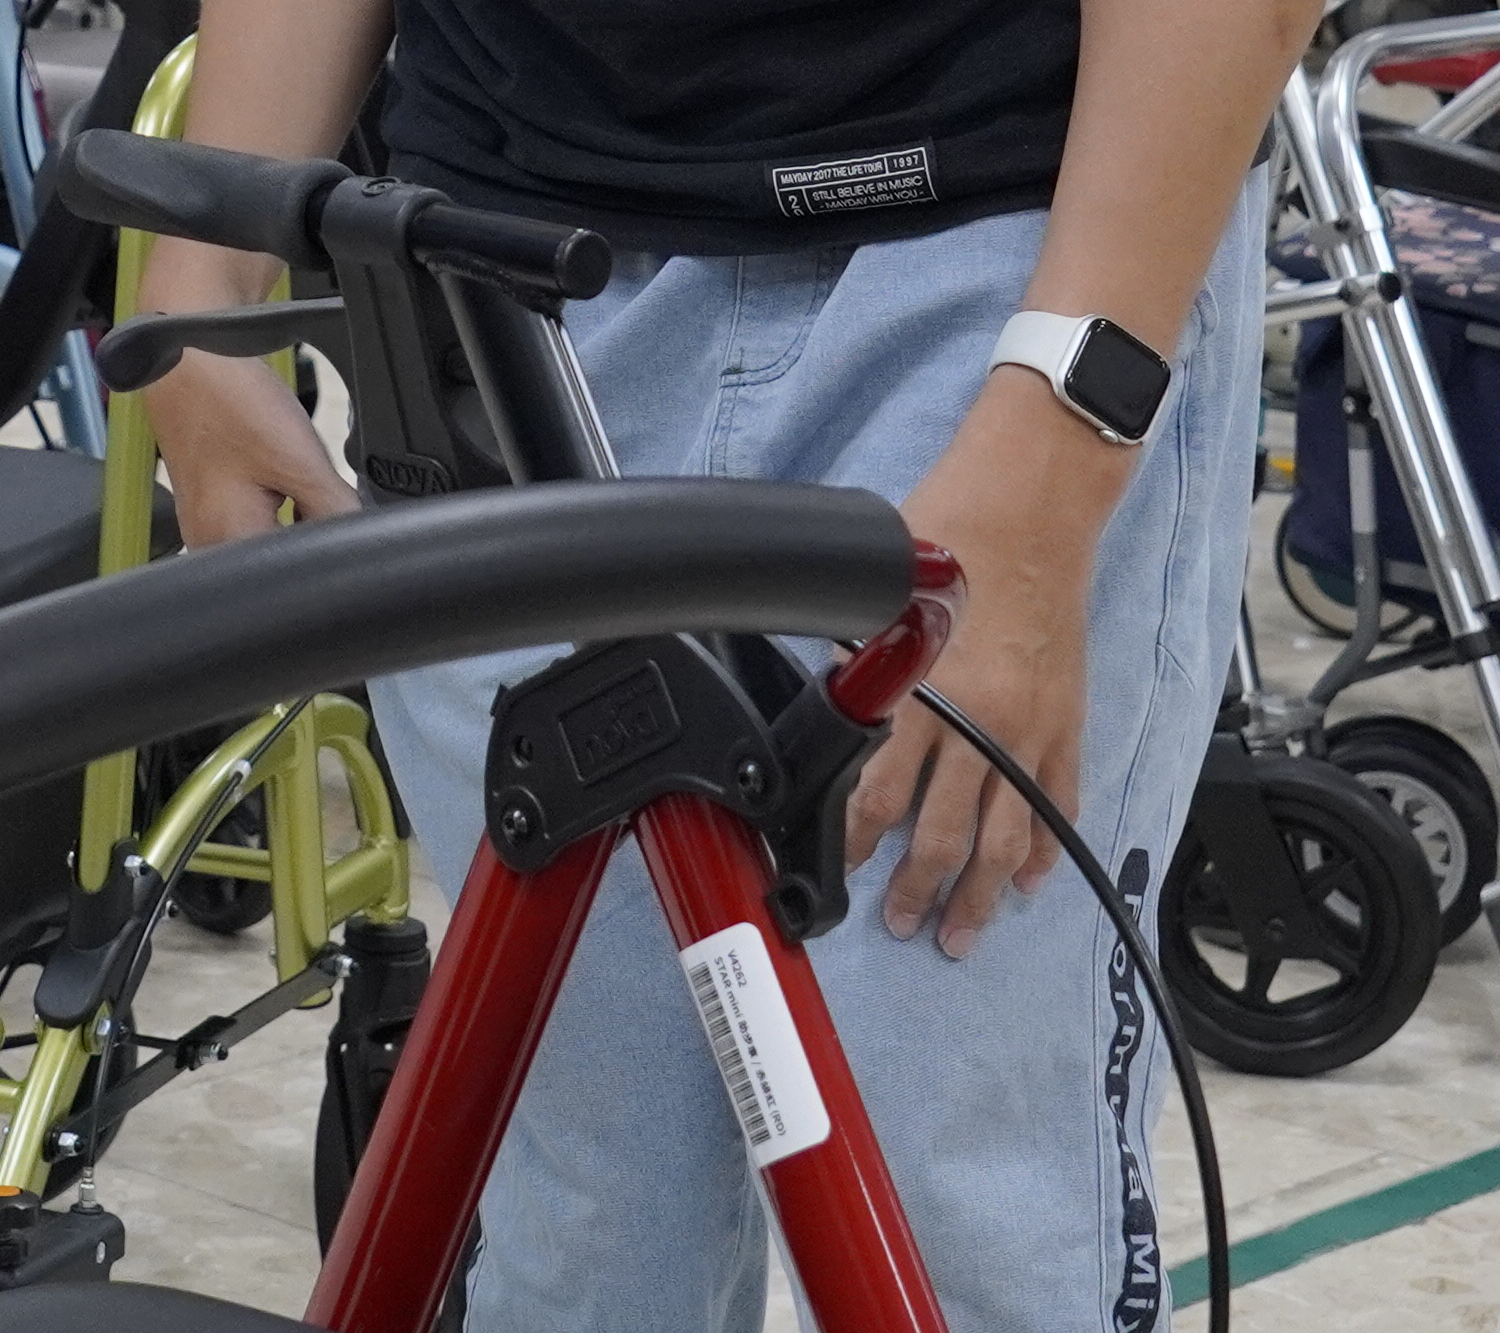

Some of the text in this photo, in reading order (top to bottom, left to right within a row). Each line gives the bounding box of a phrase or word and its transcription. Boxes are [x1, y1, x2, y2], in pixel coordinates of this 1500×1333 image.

[780, 161, 884, 185] MAYDAY 2017 THE LIFE TOUR
[892, 155, 920, 169] 1997
[812, 175, 923, 202] STILL BELIEVE IN MUSIC
[825, 189, 918, 210] MAYDAY WITH YOU
[727, 949, 747, 988] V4262
[714, 956, 732, 989] STAR
[727, 990, 742, 1019] mini
[770, 1110, 787, 1136] (RD)
